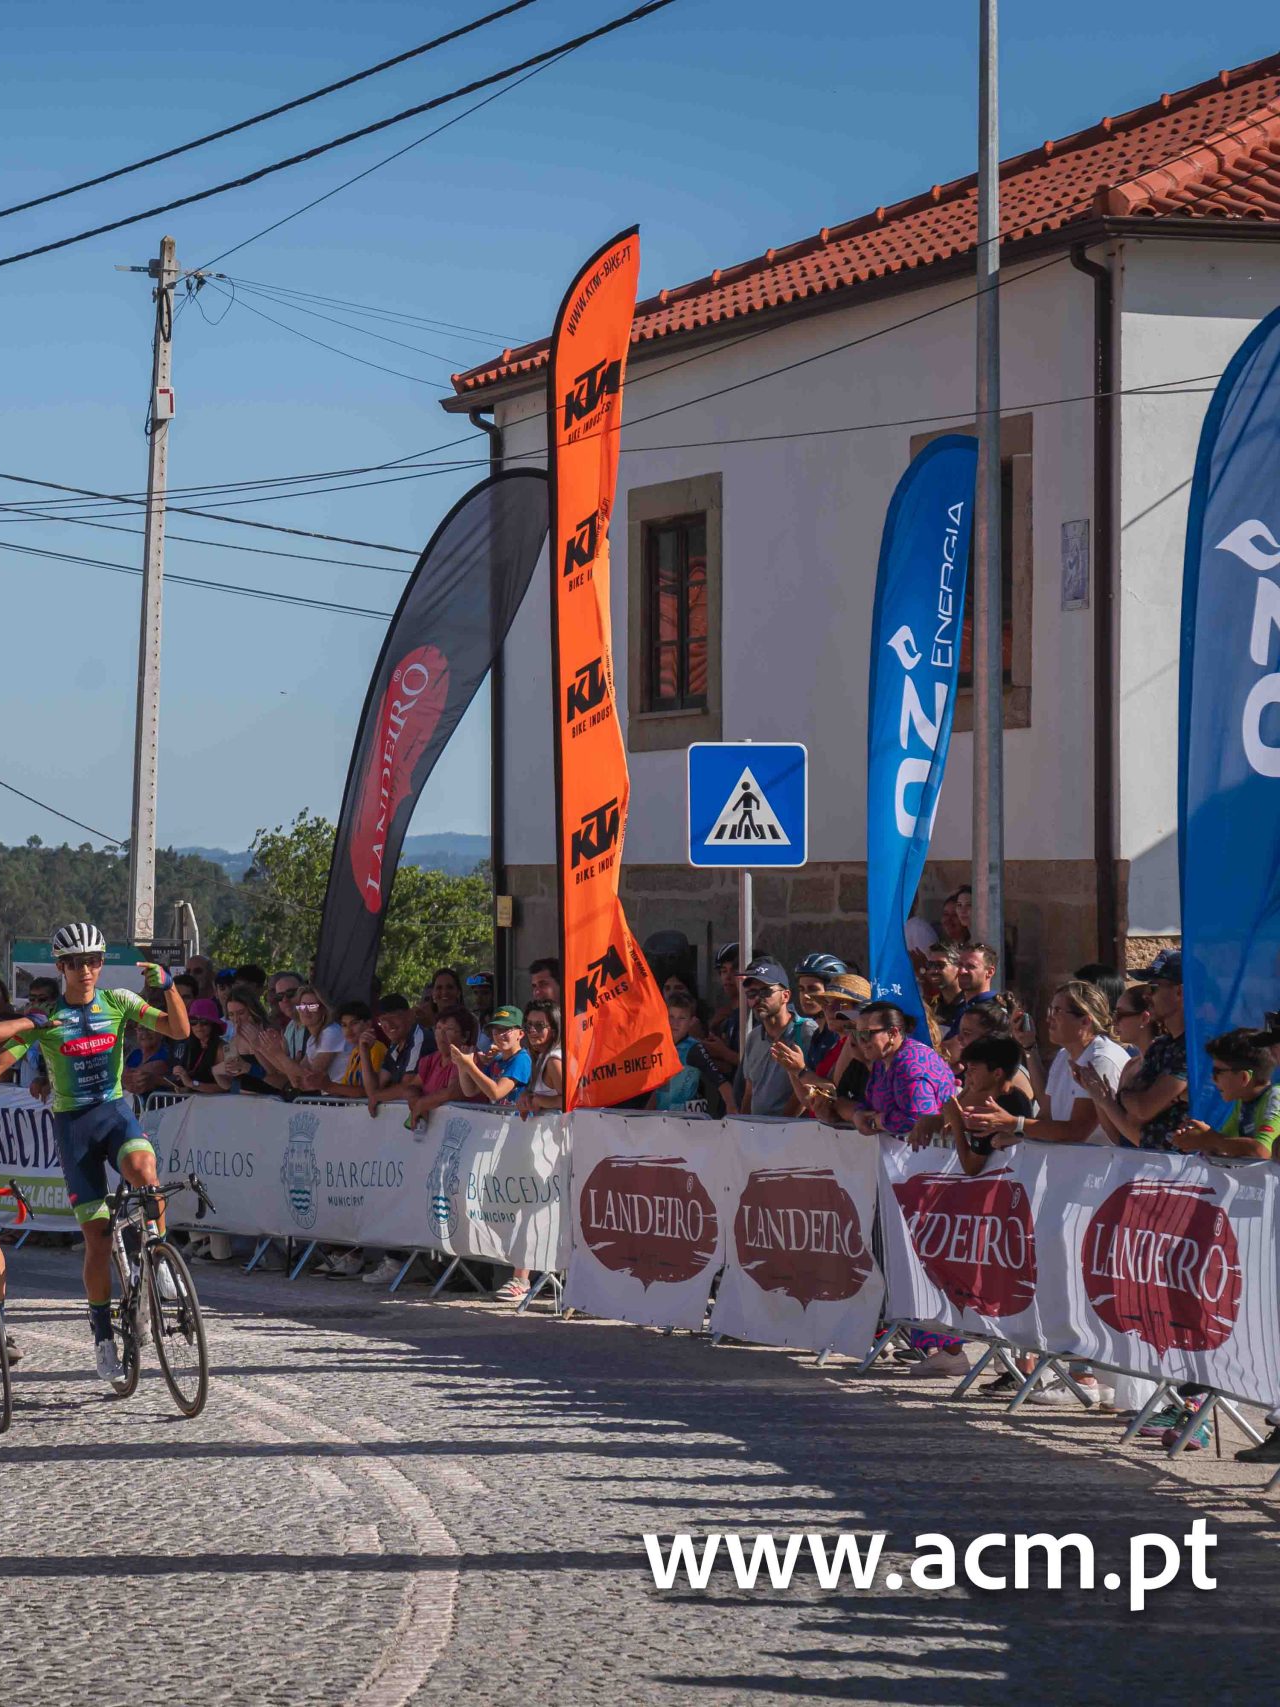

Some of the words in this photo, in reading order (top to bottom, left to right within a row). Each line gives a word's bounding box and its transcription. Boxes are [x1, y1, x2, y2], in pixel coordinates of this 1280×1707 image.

[563, 509, 599, 577] KT
[568, 570, 585, 592] BIKE
[931, 501, 964, 669] ENERGIA
[572, 716, 587, 739] BIKE
[576, 866, 595, 885] BIKE
[579, 1053, 663, 1089] W.KTM-BIKE.PT
[168, 1148, 255, 1178] BARCELOS
[326, 1160, 405, 1188] BARCELOS
[589, 1188, 704, 1243] LANDEIRO
[742, 1205, 866, 1258] LANDEIRO
[1091, 1223, 1229, 1303] LANDEIRO
